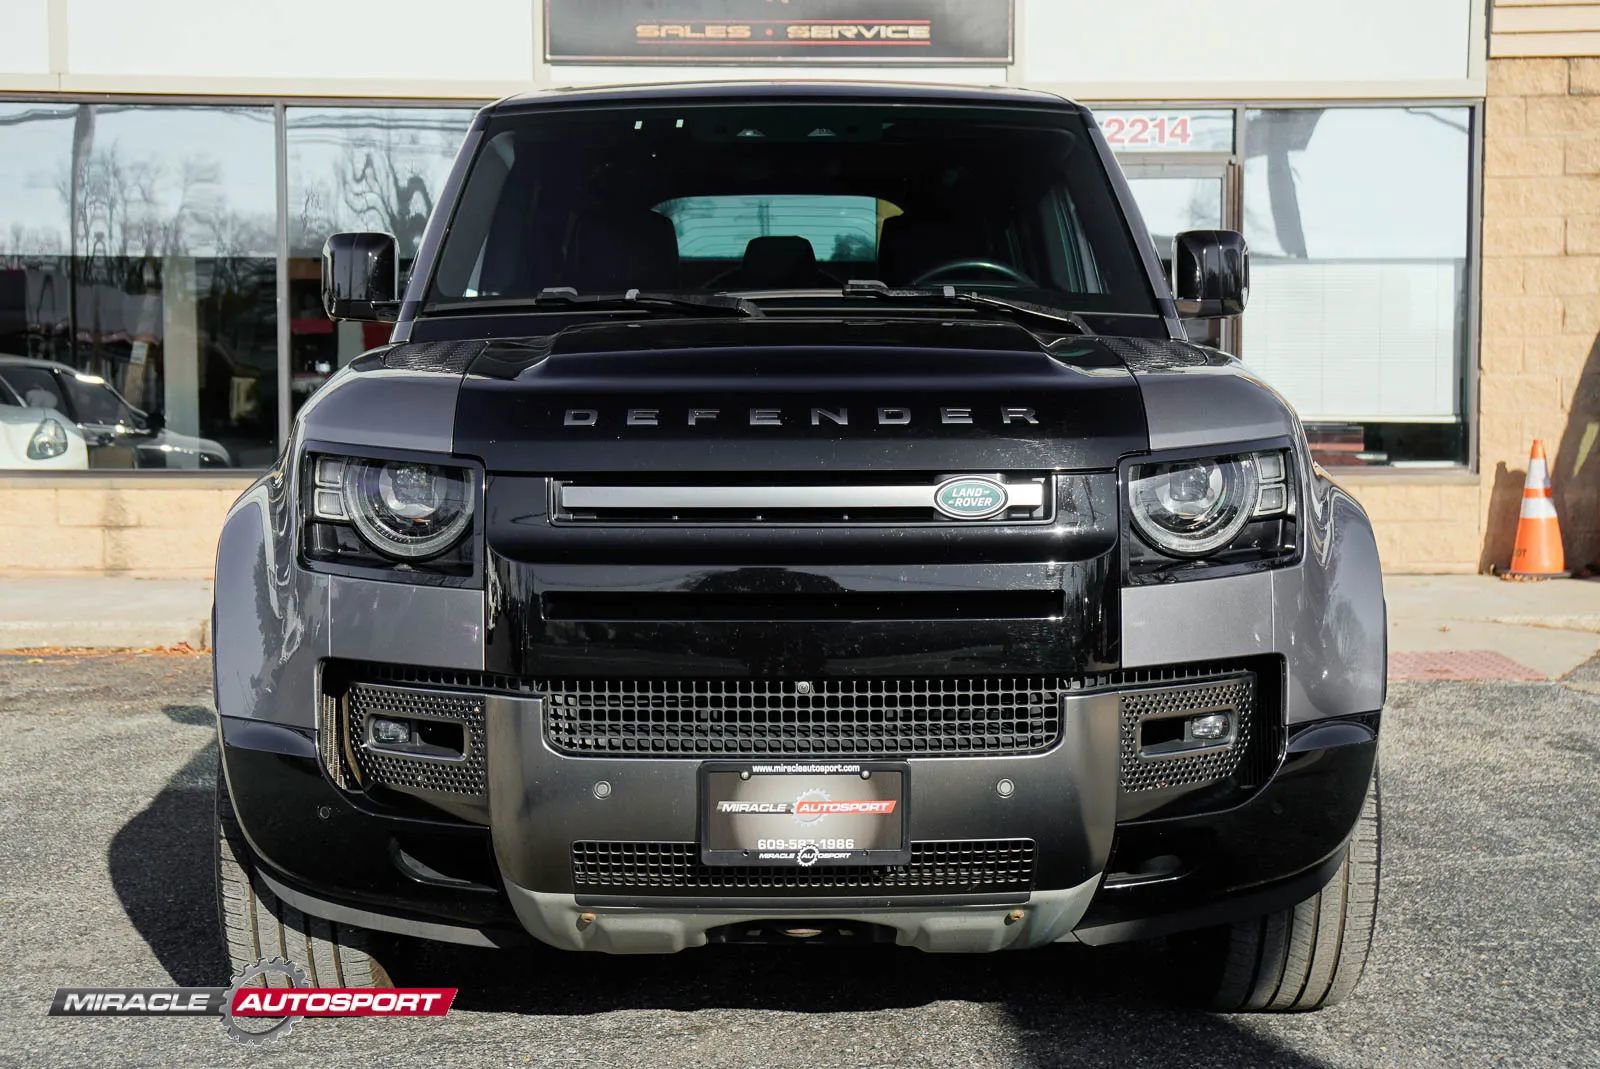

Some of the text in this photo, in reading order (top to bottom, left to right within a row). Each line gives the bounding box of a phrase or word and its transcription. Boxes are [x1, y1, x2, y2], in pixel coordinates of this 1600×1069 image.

[636, 24, 931, 39] SALES SERVICE
[1103, 116, 1192, 145] 2214
[563, 407, 1040, 427] DEFENDER
[752, 763, 860, 775] www.miracleautosport.com
[721, 802, 889, 813] MIRACLE AUTOSPORT
